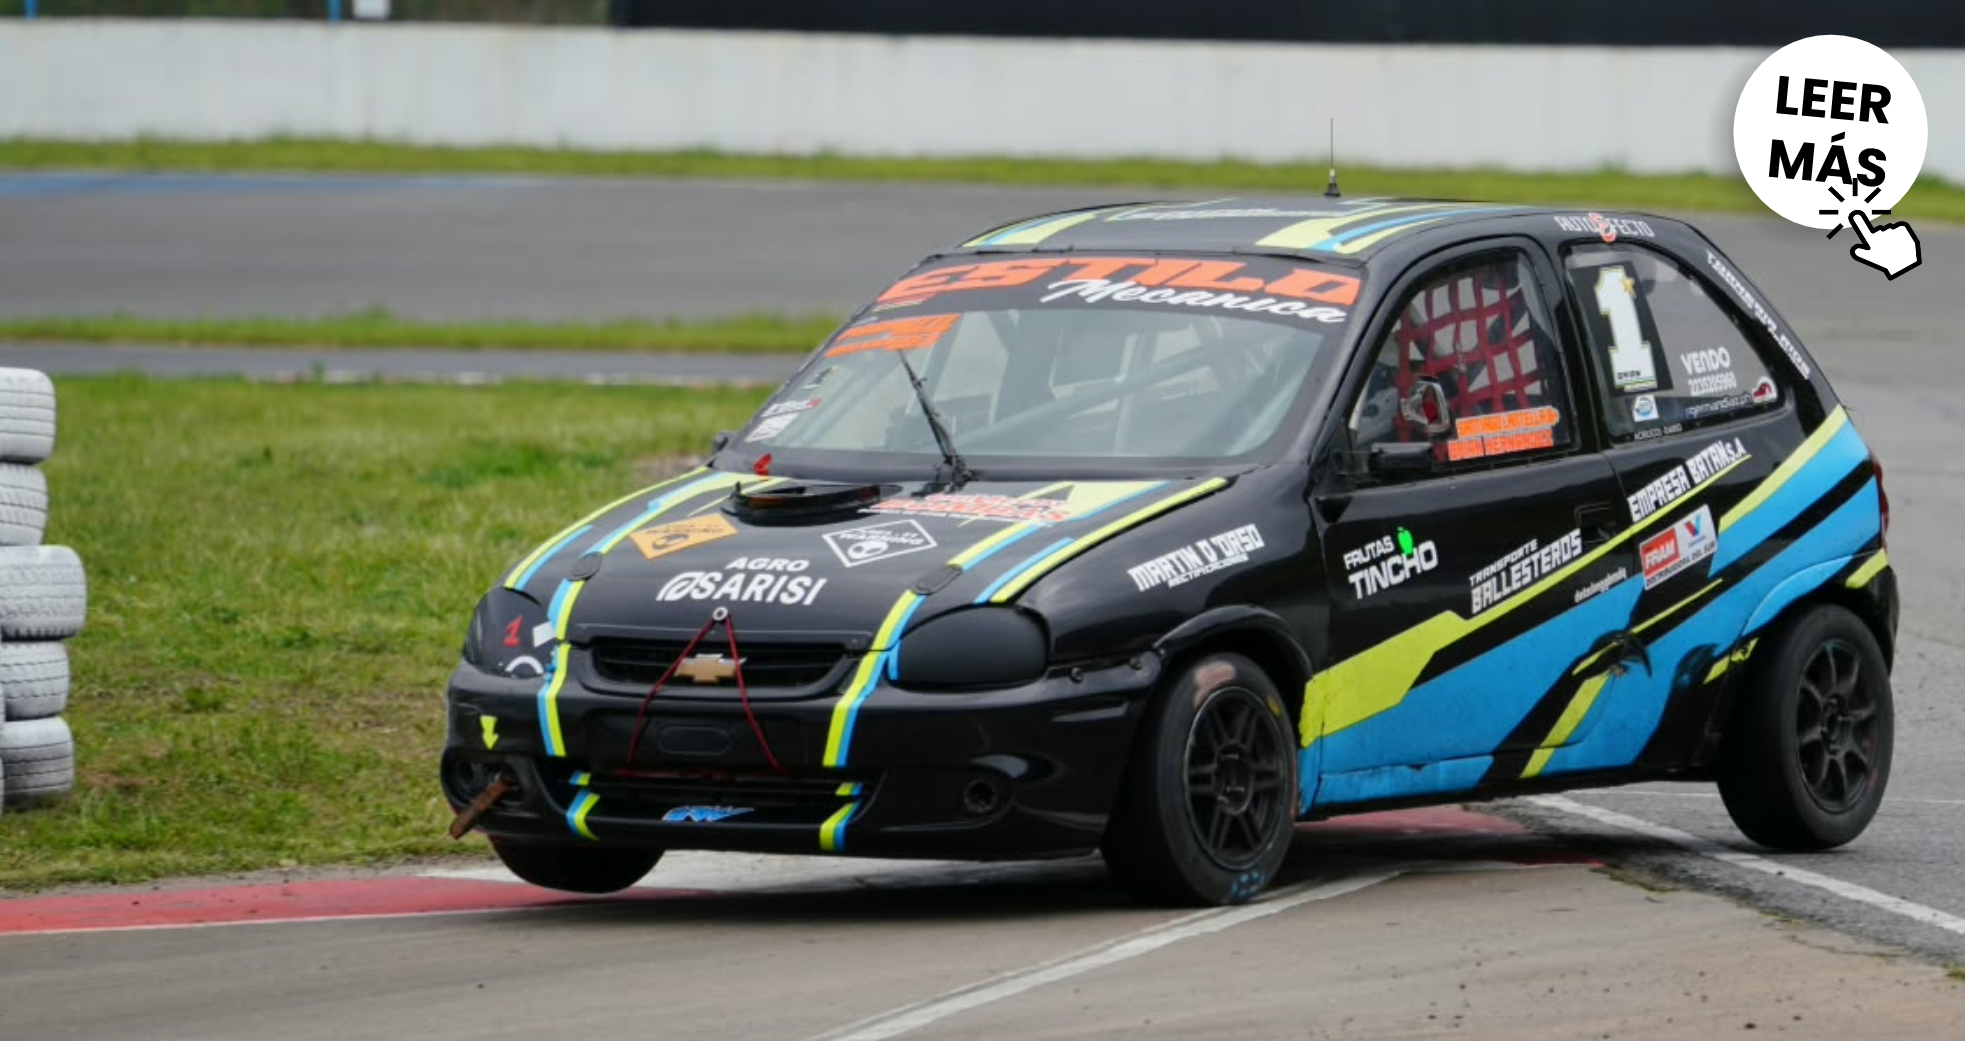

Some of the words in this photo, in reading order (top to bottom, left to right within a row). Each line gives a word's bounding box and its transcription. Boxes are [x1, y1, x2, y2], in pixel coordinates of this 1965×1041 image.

[875, 258, 1362, 306] ESTILO
[1040, 278, 1347, 324] Mecanica
[1594, 265, 1657, 390] 1
[1680, 346, 1731, 375] VENDO
[1627, 464, 1692, 523] EMPRESA
[725, 556, 810, 572] AGRO
[1127, 545, 1204, 592] MARTIN
[1343, 535, 1395, 570] FRUTAS
[1348, 540, 1438, 600] TINCHO
[1469, 538, 1538, 587] TRANSPORTE
[1471, 528, 1582, 614] BALLESTEROS
[1644, 539, 1676, 570] FRAM
